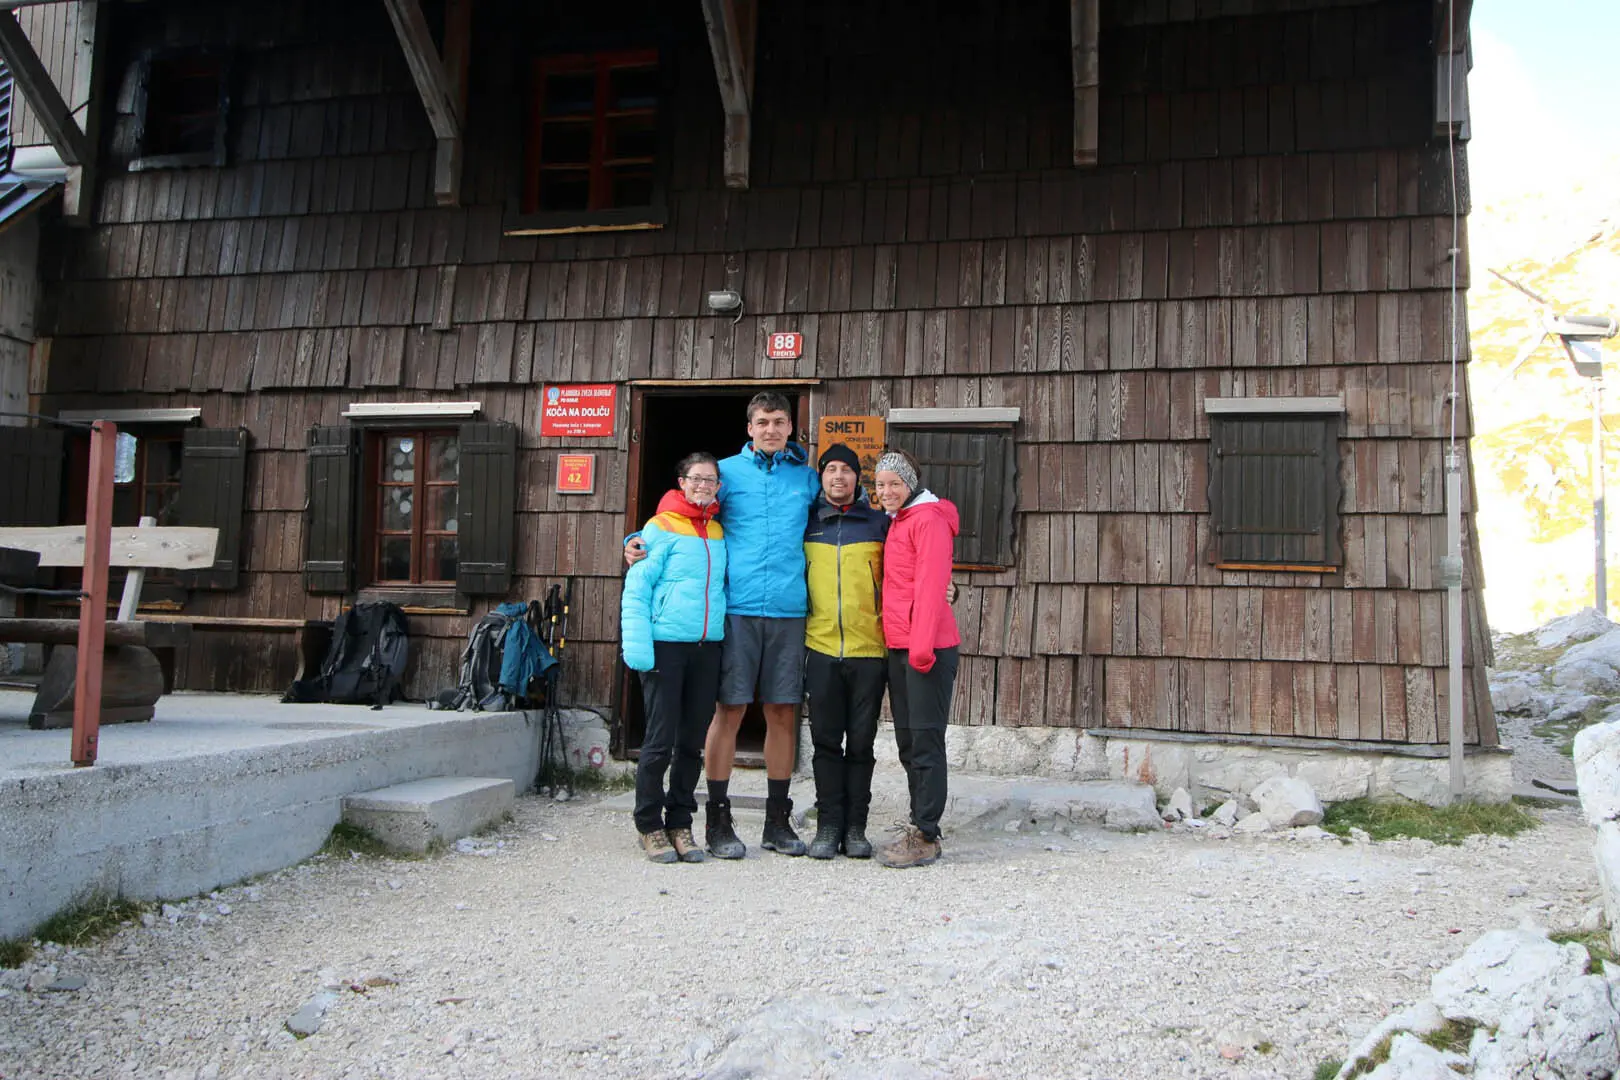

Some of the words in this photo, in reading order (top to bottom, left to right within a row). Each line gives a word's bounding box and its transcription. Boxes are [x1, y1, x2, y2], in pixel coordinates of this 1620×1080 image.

[774, 335, 795, 349] 88
[546, 405, 567, 417] KOČA
[568, 408, 580, 417] NA
[581, 405, 610, 417] DOLIČU
[825, 421, 865, 434] SMETI
[568, 473, 582, 483] 42
